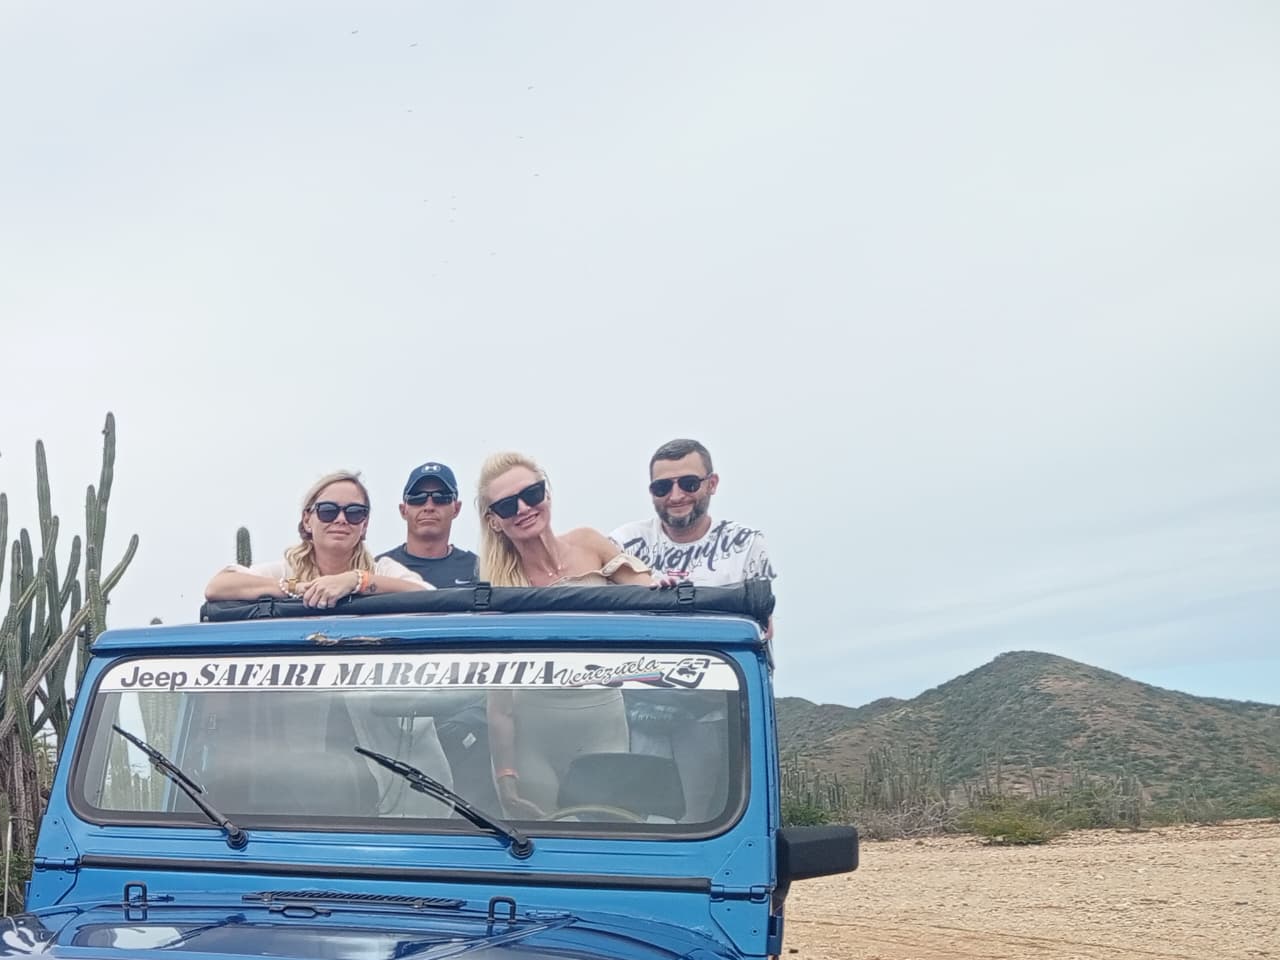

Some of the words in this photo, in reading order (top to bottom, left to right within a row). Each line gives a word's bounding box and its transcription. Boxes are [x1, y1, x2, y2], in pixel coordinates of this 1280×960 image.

[121, 666, 187, 691] Jeep
[194, 663, 326, 687] SAFARI
[331, 660, 554, 686] MARGARITA
[554, 656, 660, 684] Venezuela
